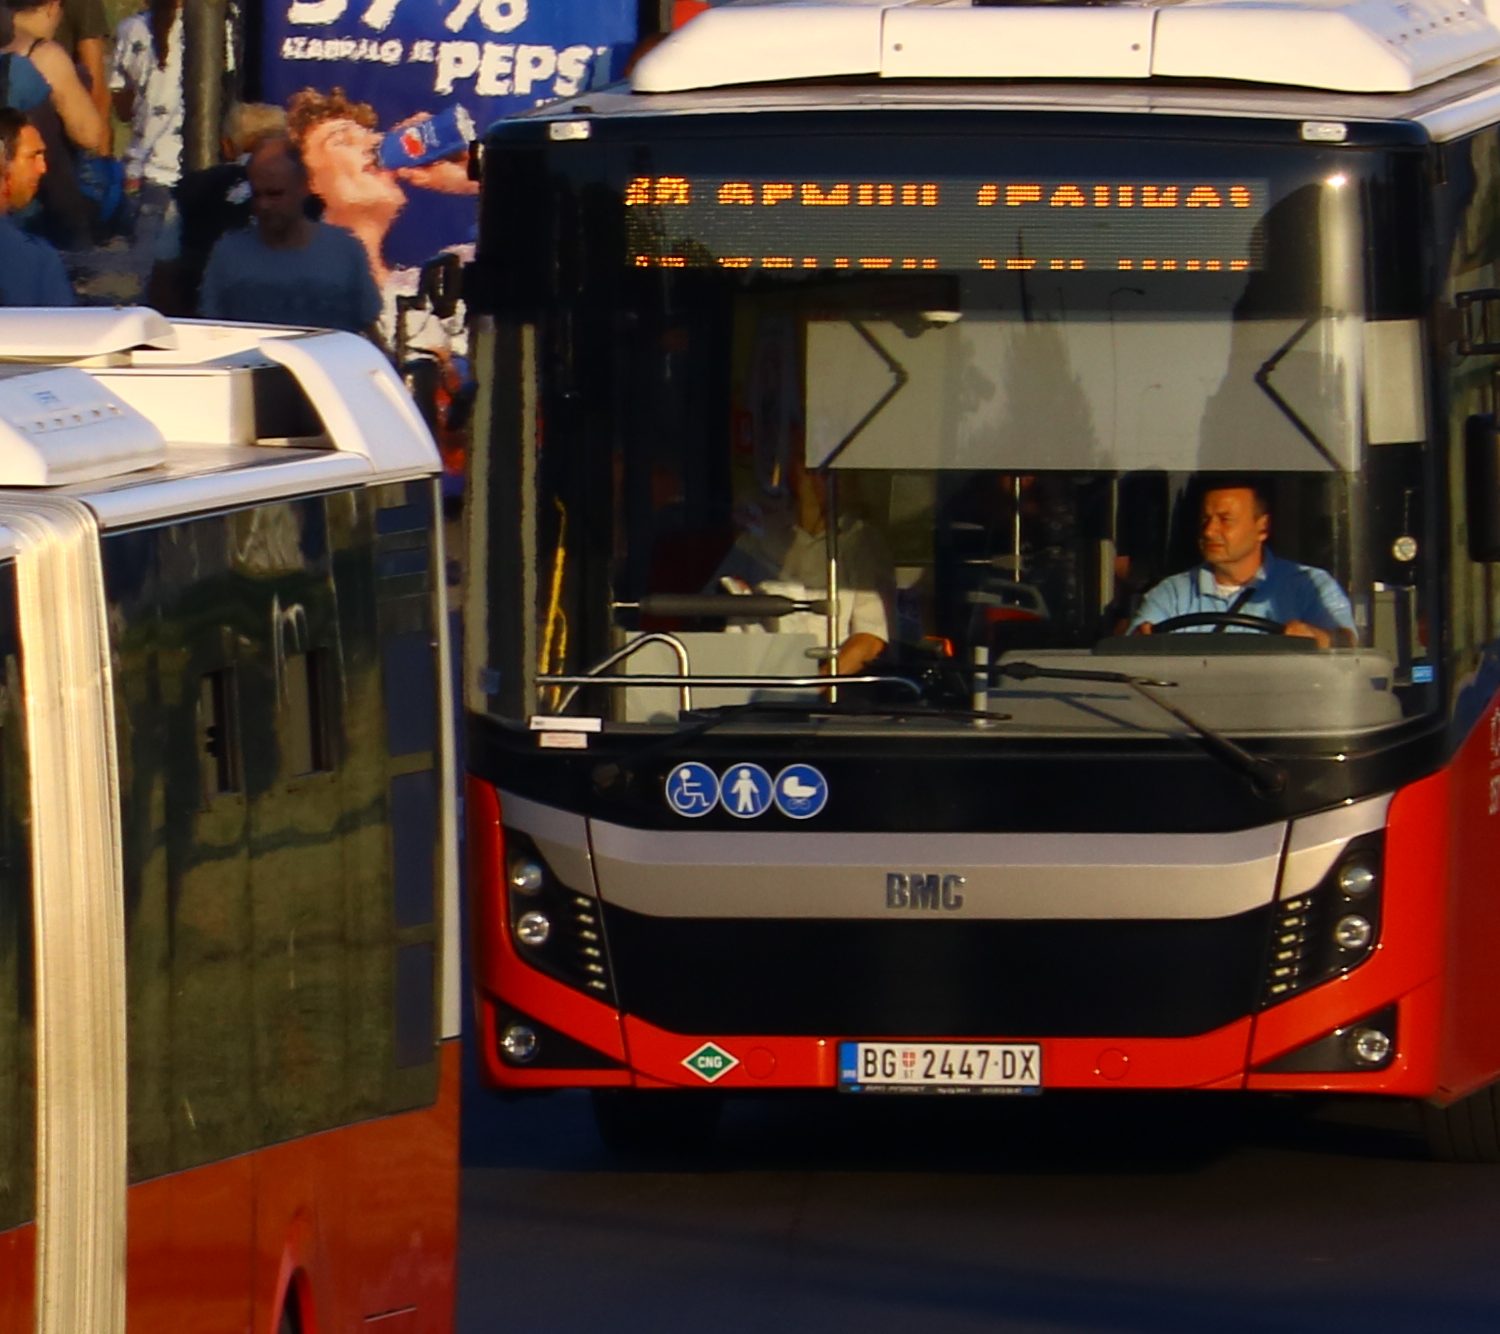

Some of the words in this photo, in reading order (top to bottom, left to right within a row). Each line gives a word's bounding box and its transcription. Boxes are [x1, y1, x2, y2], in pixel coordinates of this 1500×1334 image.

[433, 40, 600, 97] PEPS
[886, 873, 966, 910] BMC
[697, 1055, 723, 1069] CNG
[863, 1048, 897, 1078] BG
